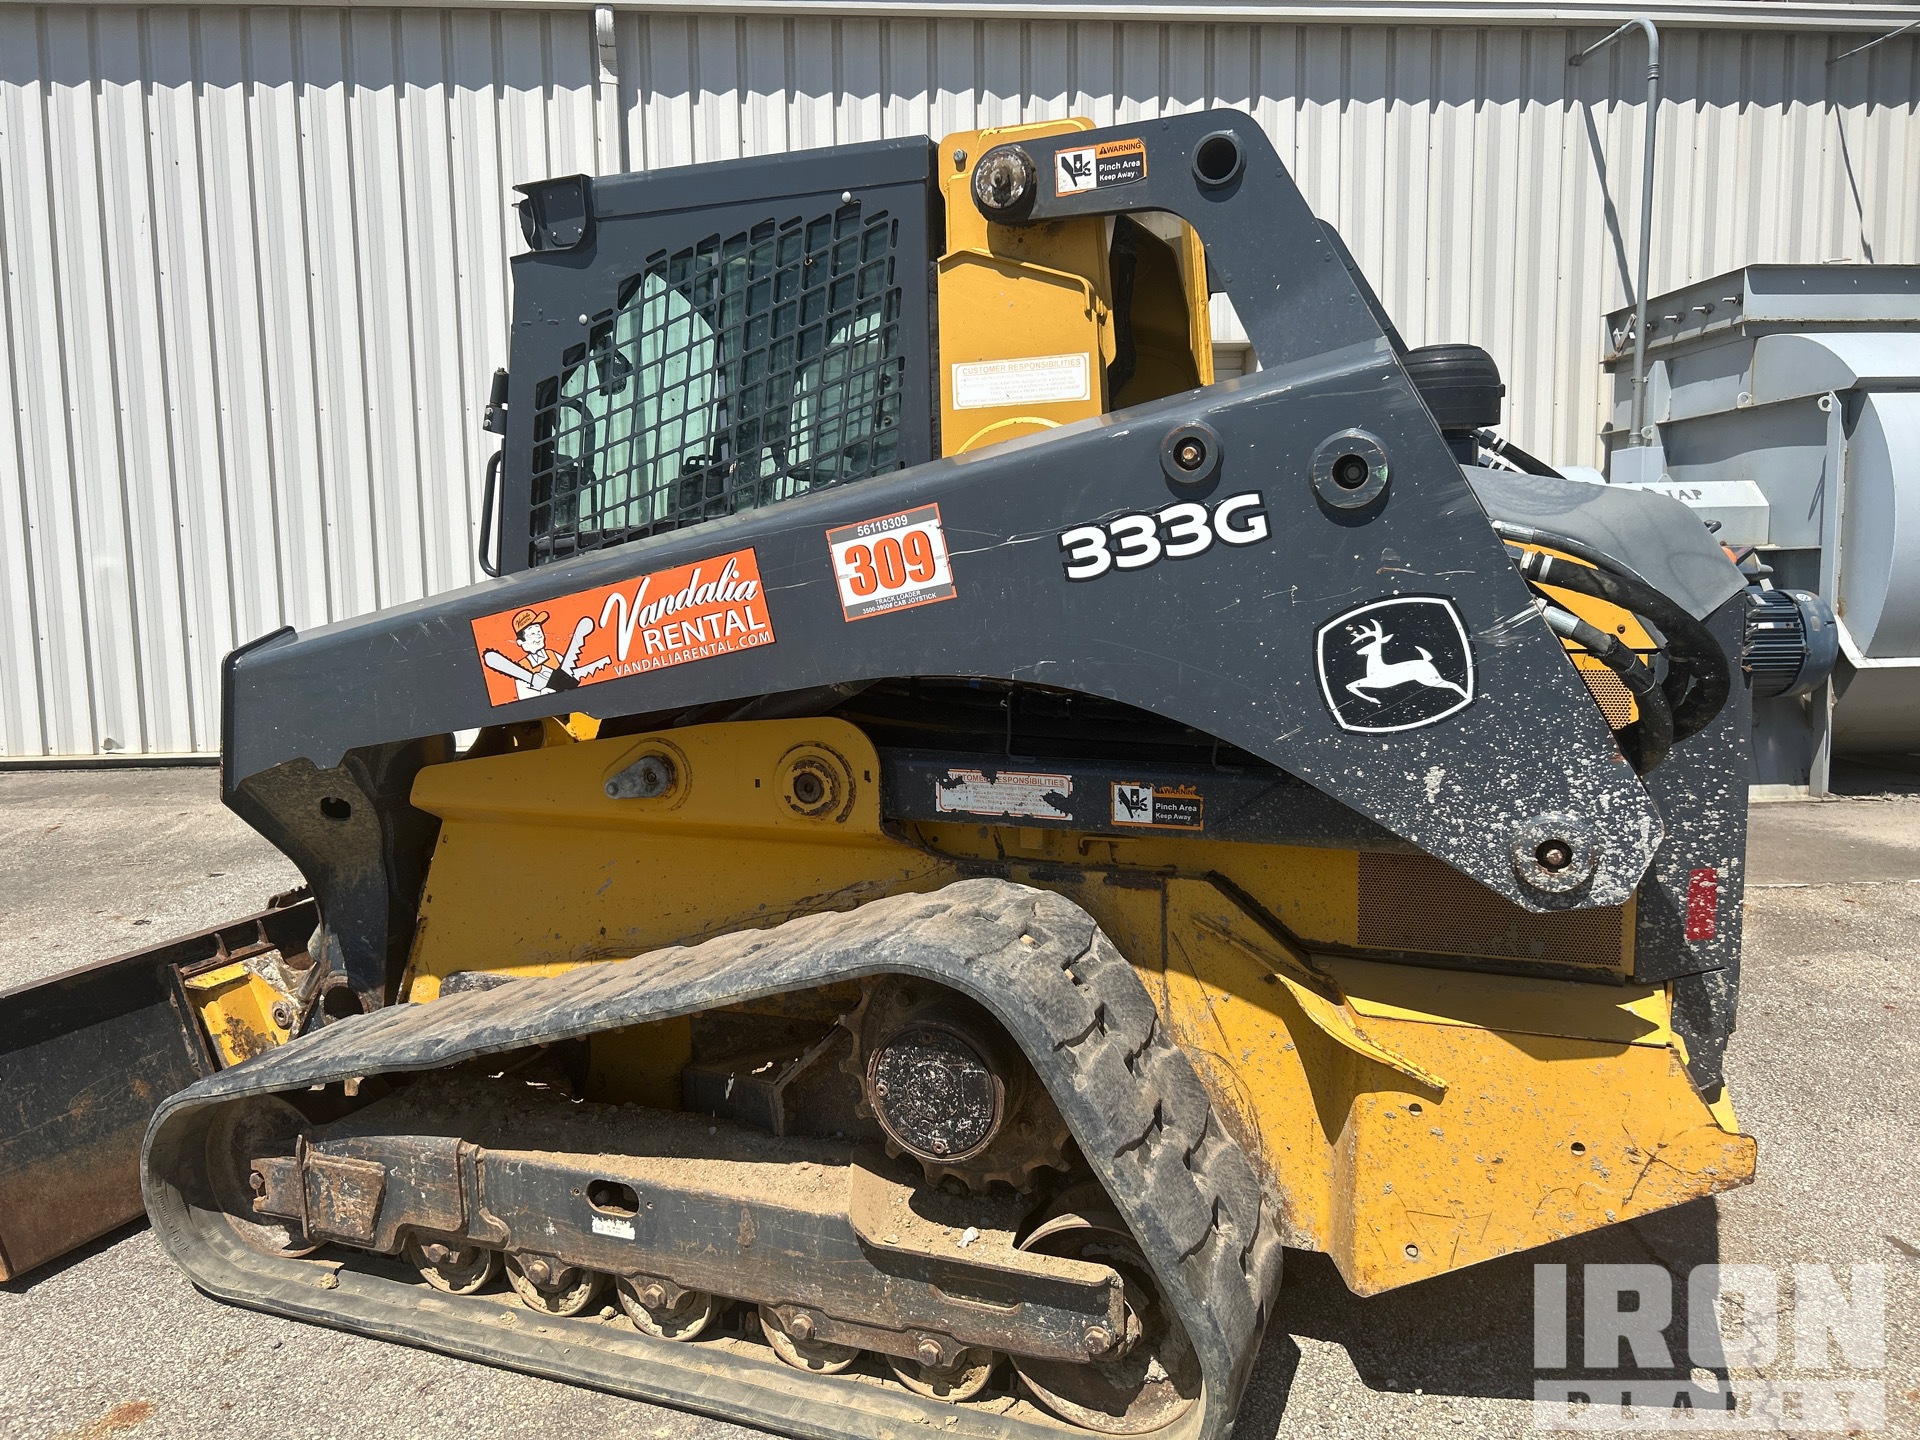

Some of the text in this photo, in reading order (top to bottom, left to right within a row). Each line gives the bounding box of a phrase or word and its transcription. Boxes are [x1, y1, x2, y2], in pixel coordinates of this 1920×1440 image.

[1106, 143, 1142, 154] WARNING
[1099, 160, 1141, 172] Pinch Area
[1099, 171, 1135, 182] Keep Away
[962, 358, 1081, 375] CUSTOMER RESPONSIBILITIES
[857, 515, 908, 537] 56118309
[1060, 492, 1269, 580] 333G
[844, 530, 936, 596] 309
[875, 590, 921, 606] TRACK LOADER
[894, 599, 907, 607] CAB
[907, 592, 937, 604] JOYSTICK
[599, 557, 759, 661] Vandalia
[641, 605, 766, 655] RENTAL
[614, 631, 771, 677] VANDALIARENTAL.COM
[995, 775, 1065, 787] ESPONSIBILITIES
[1155, 802, 1197, 812] Pinch Area
[1155, 812, 1172, 820] Keep
